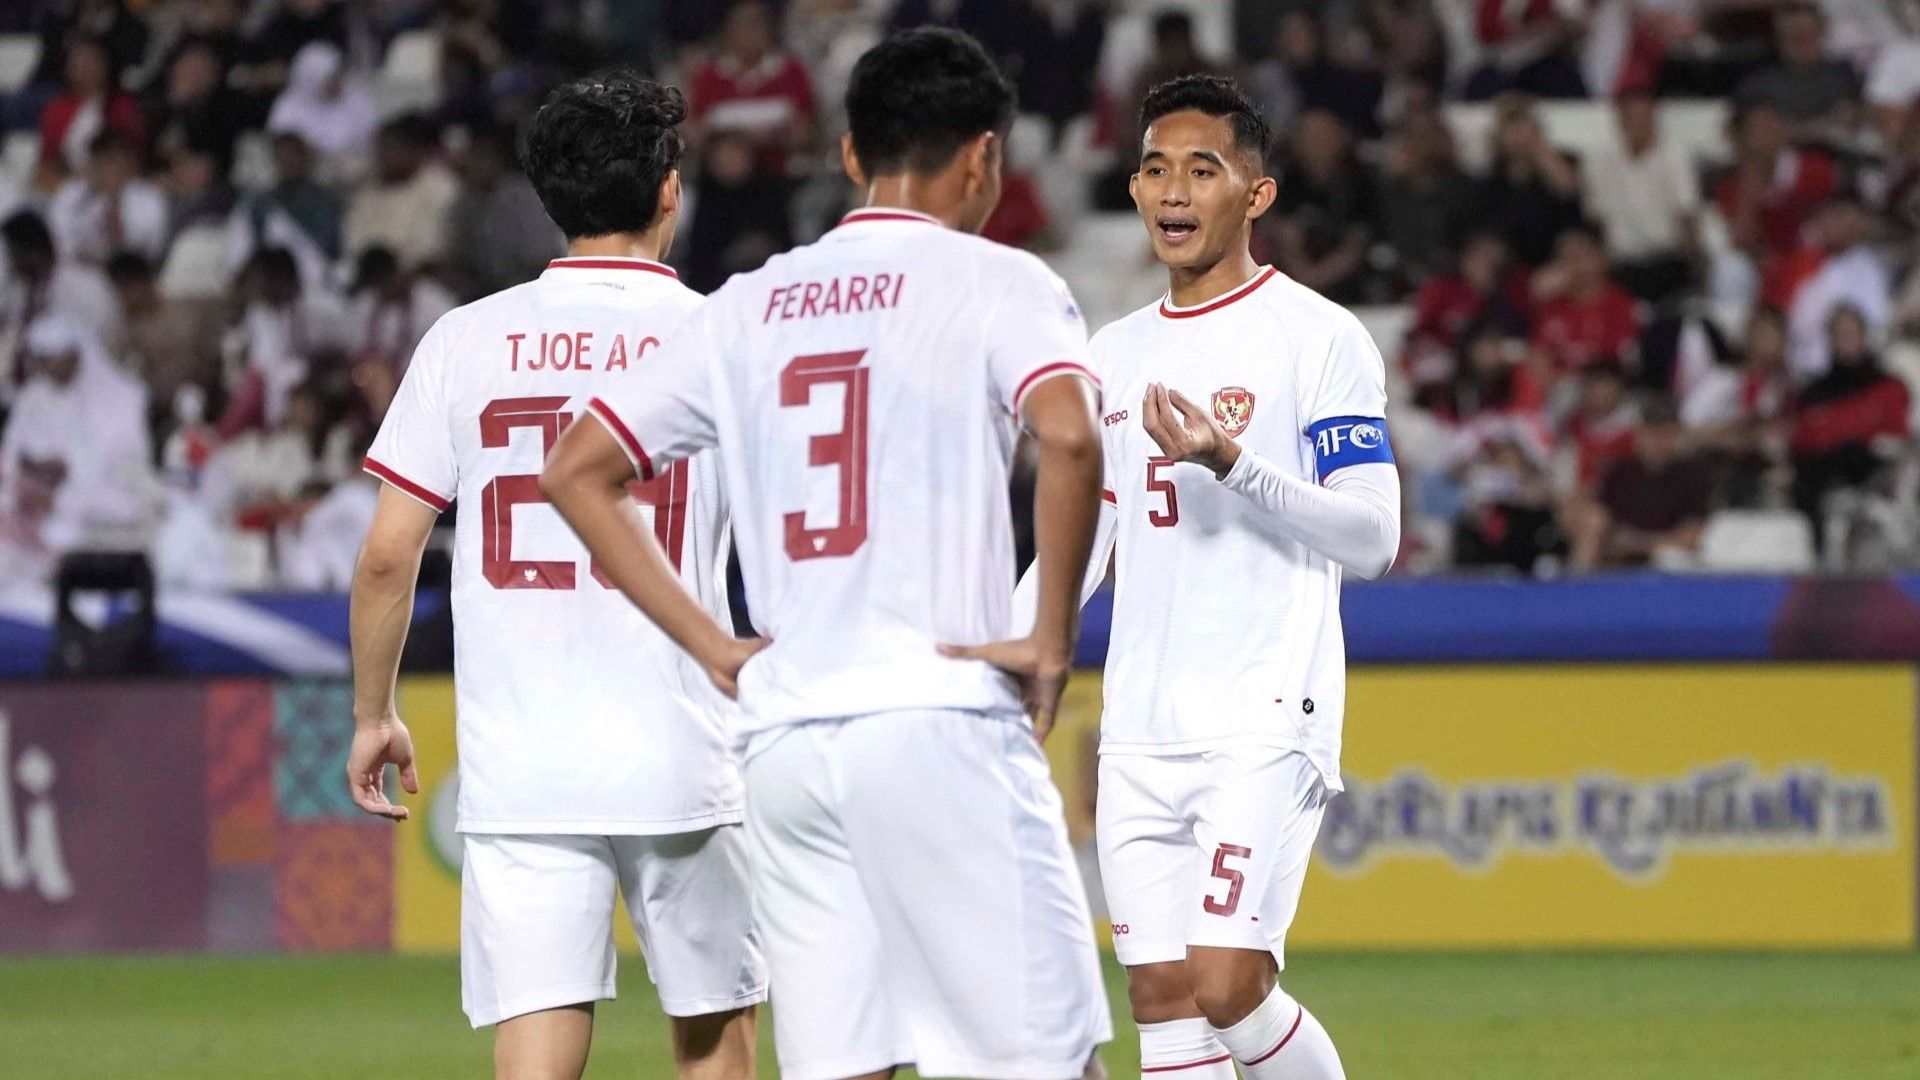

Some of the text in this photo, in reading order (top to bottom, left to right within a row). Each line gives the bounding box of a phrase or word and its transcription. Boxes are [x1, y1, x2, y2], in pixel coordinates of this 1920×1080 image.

[764, 273, 905, 323] FERARRI
[779, 347, 870, 562] 3
[1315, 423, 1382, 457] AFC
[1146, 455, 1179, 528] 5
[1203, 842, 1252, 917] 5
